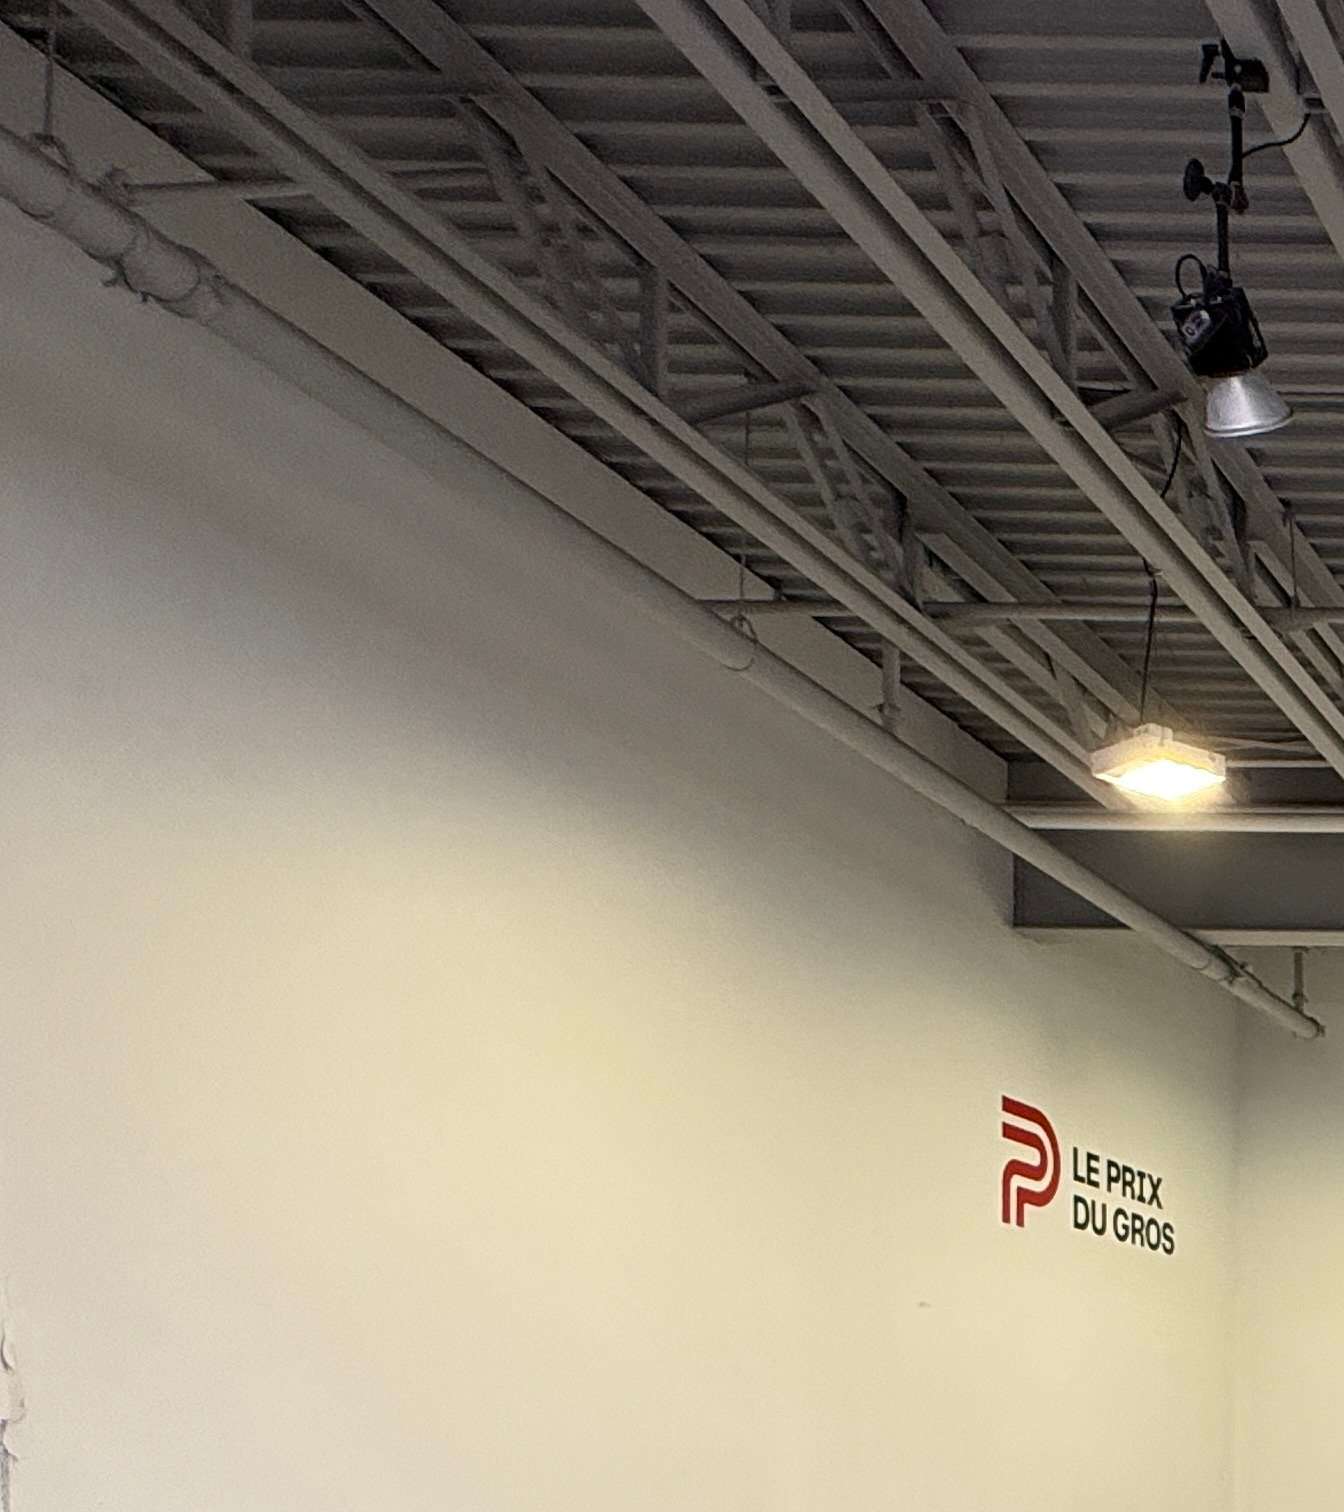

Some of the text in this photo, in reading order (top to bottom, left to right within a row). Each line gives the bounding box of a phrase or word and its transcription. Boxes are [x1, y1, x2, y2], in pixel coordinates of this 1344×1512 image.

[1073, 1146, 1163, 1210] LE PRIX
[1073, 1194, 1175, 1255] DU GROS
